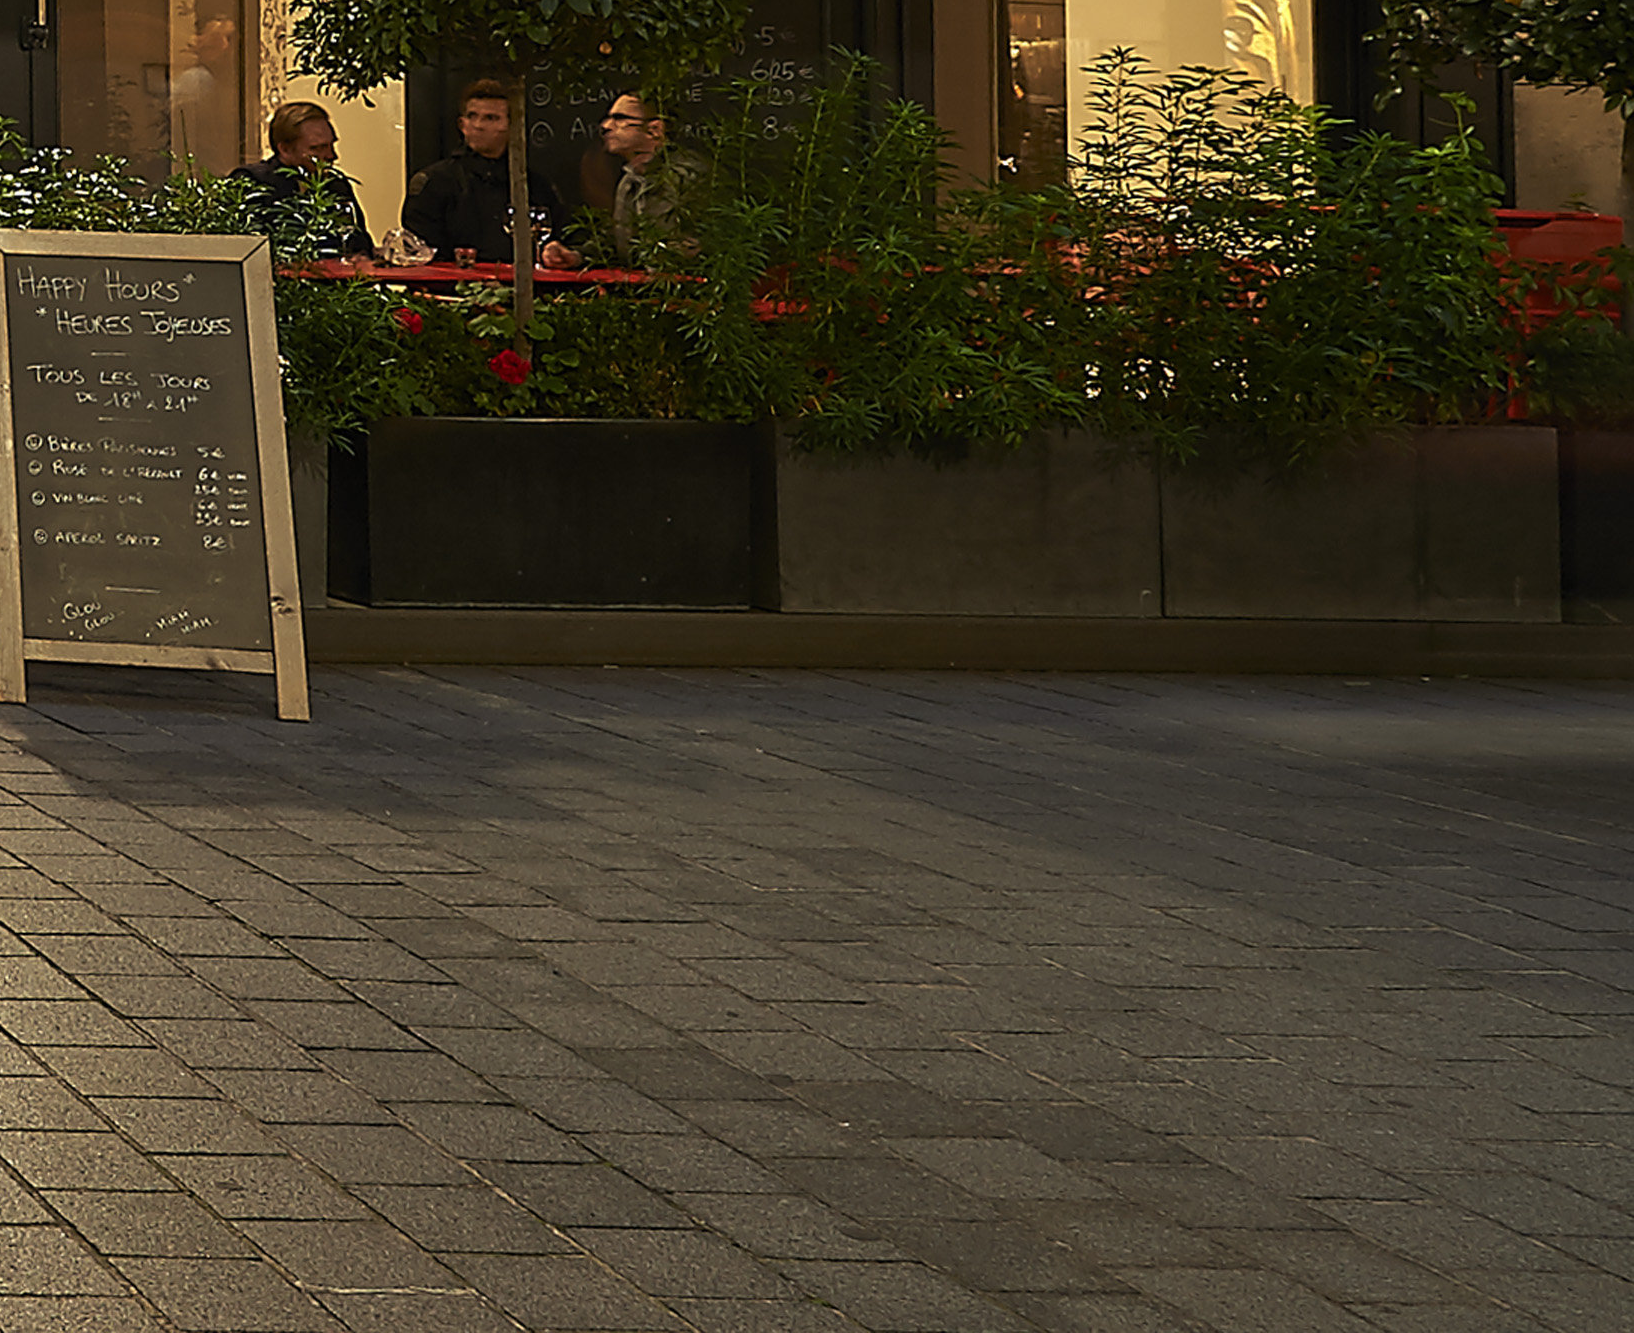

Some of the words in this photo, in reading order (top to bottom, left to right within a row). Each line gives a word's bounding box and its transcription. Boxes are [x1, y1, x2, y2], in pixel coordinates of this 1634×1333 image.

[16, 265, 87, 303] HAPPY
[104, 267, 181, 303] HOURS
[55, 307, 133, 336] HEURES
[139, 310, 232, 342] JOYEUSES
[26, 363, 85, 385] TOUS
[99, 370, 139, 387] LES
[150, 372, 211, 391] JOURS
